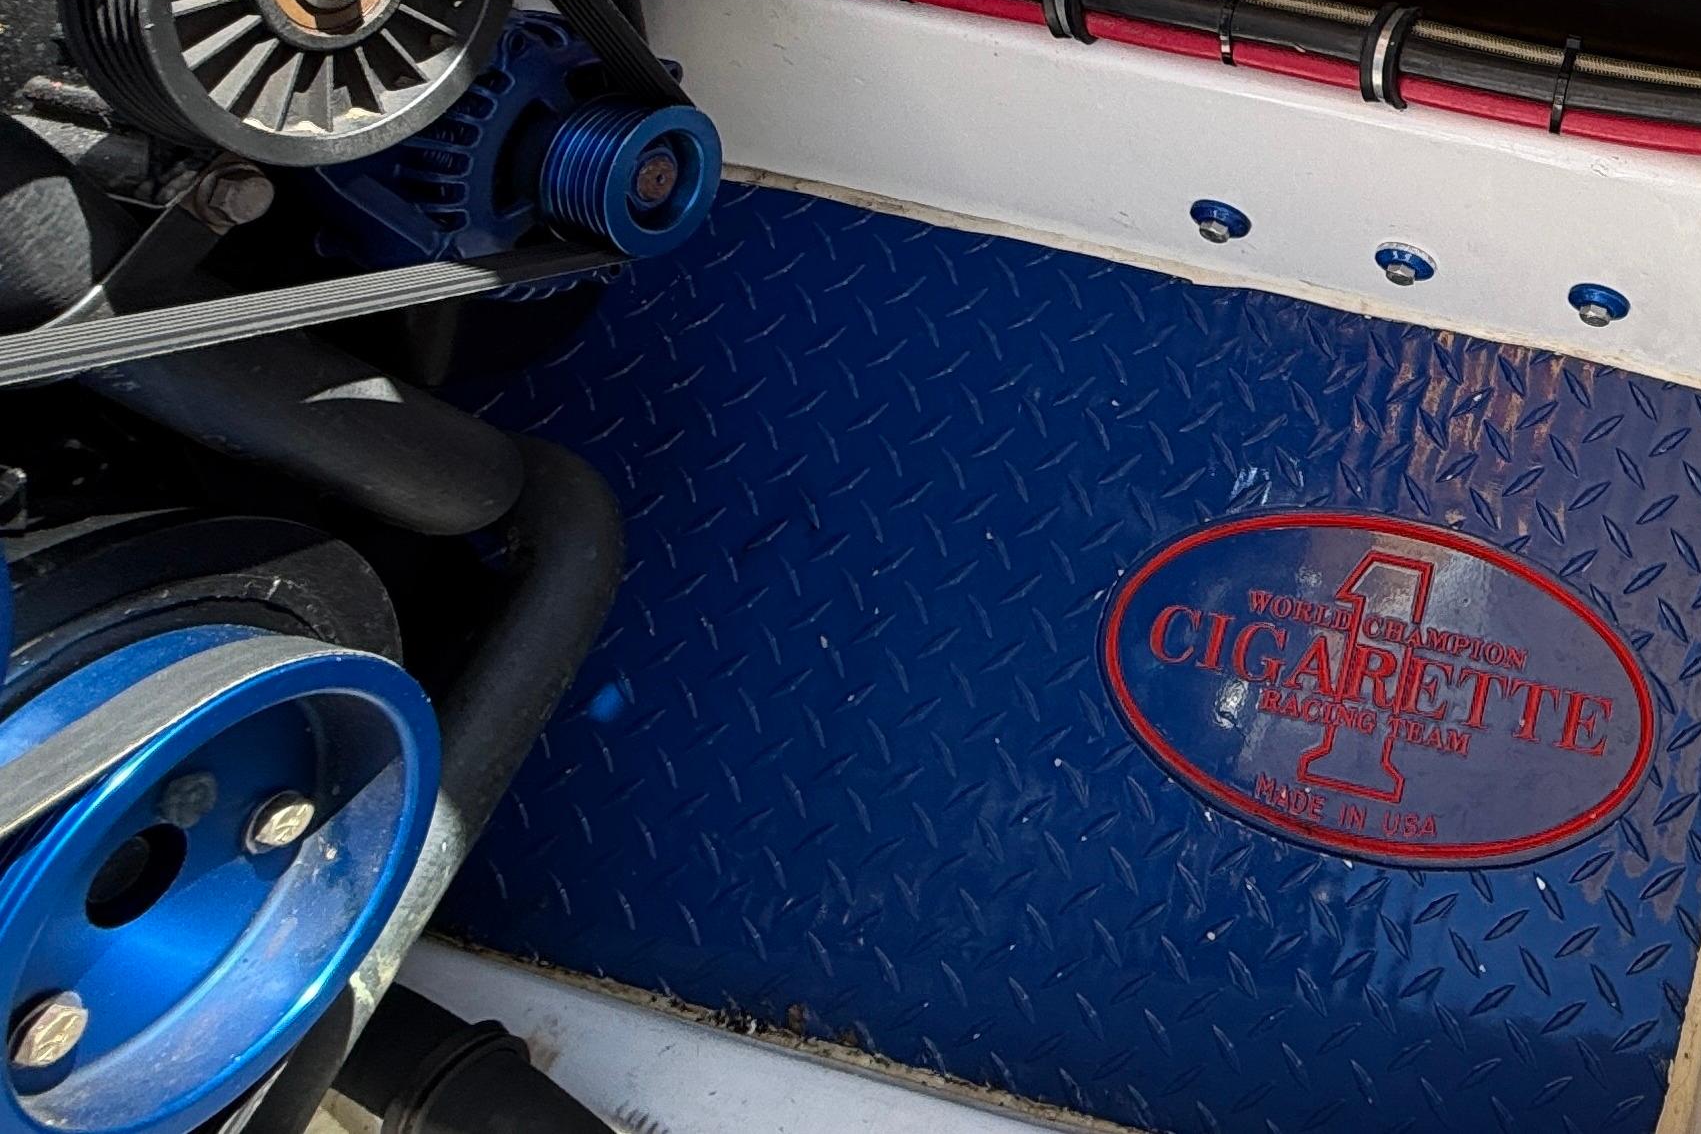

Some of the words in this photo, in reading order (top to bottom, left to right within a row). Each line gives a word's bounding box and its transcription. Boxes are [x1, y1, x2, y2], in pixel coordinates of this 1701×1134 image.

[1248, 588, 1354, 632] WORLD
[1362, 617, 1529, 670] CHAMPION
[1149, 603, 1616, 757] CIGARETTE
[1257, 687, 1379, 736] RACING
[1386, 714, 1473, 758] TEAM
[1255, 771, 1328, 823] MADE
[1337, 802, 1368, 833] IN
[1382, 811, 1438, 838] USA
